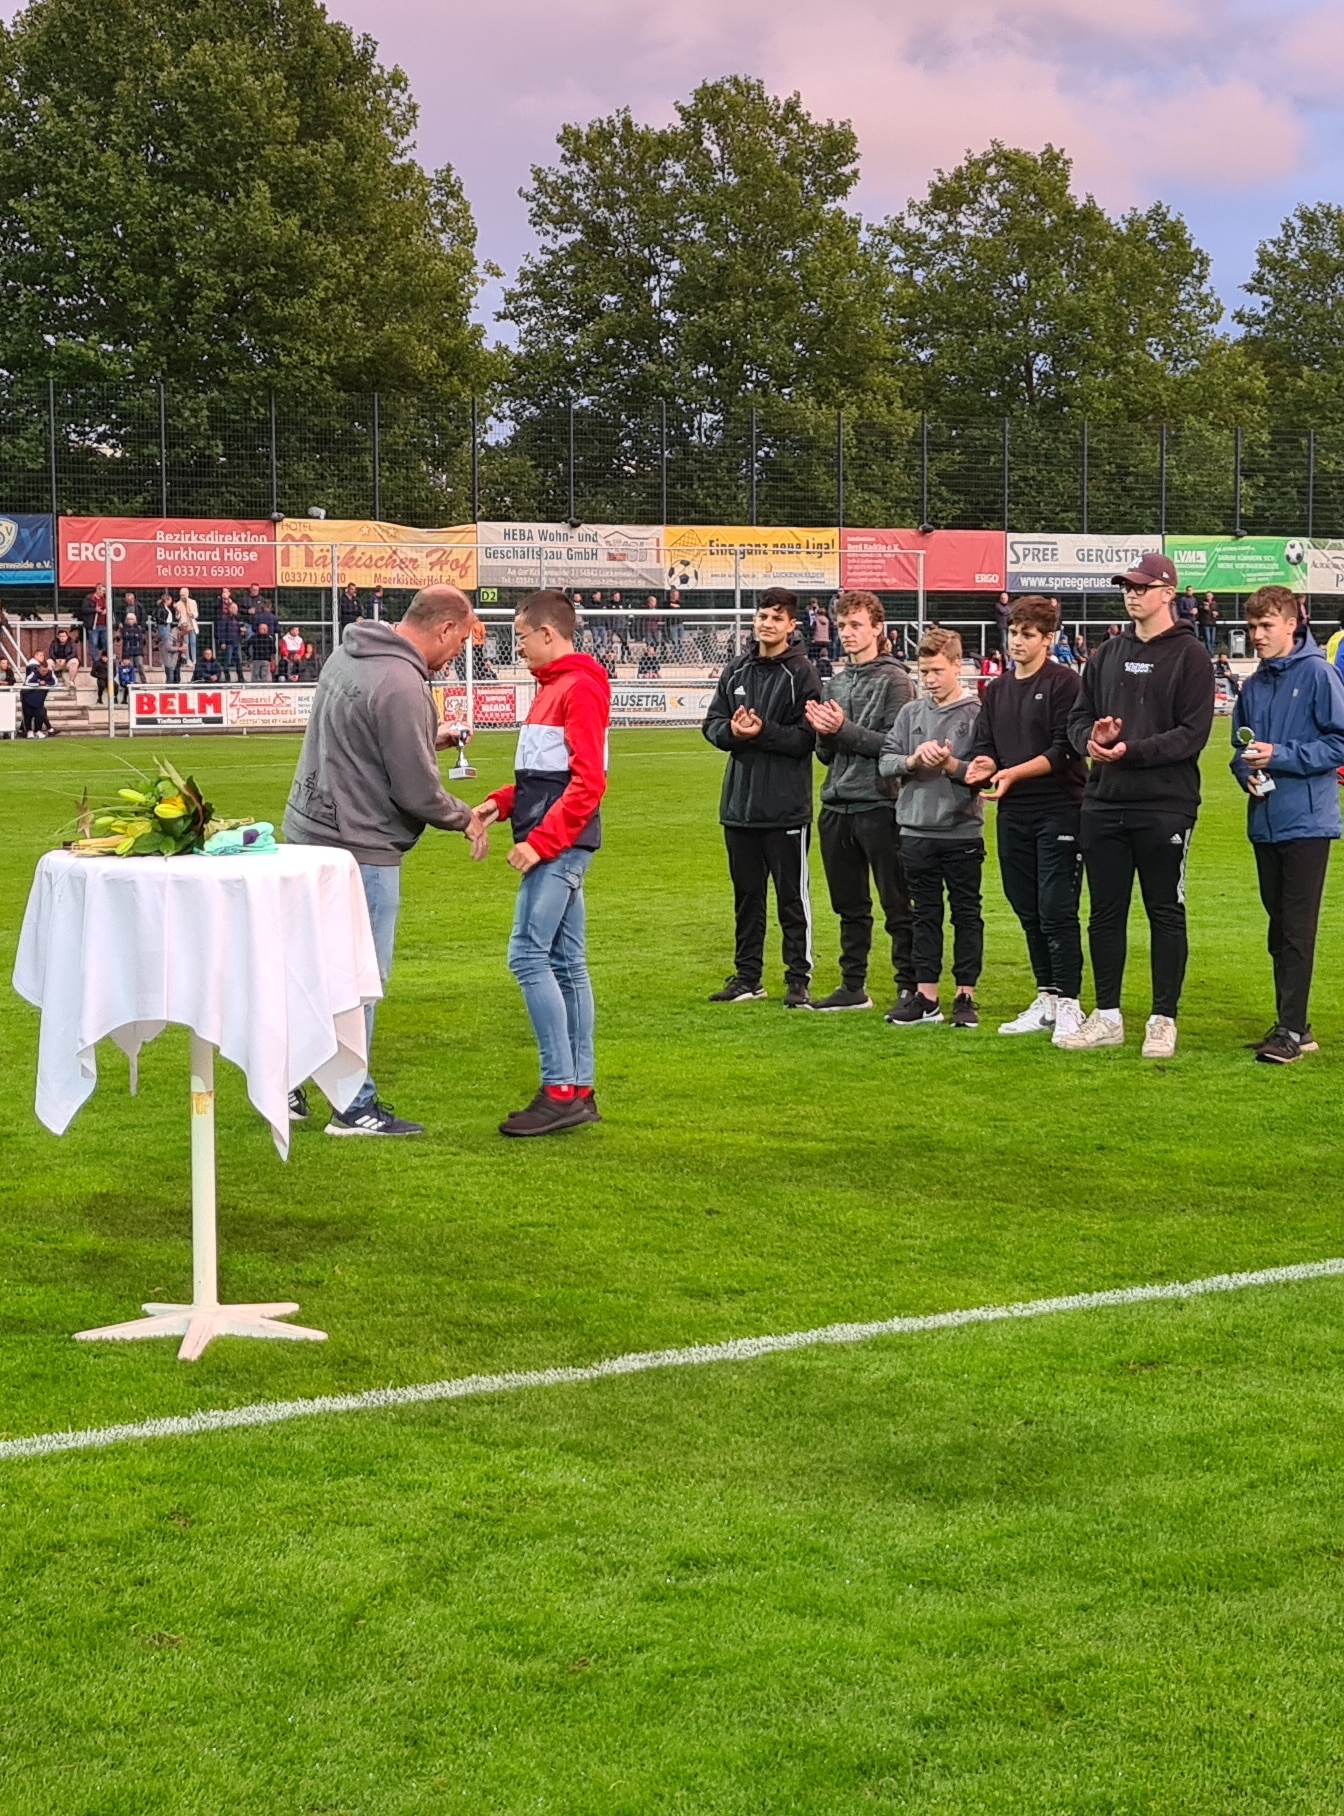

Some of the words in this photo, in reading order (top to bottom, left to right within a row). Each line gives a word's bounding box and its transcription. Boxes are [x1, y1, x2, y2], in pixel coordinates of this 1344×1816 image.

[281, 522, 312, 532] HOTEL
[156, 530, 267, 544] Bezirksdirektion
[503, 528, 534, 541] HEBA
[538, 529, 574, 542] Wohn-
[577, 532, 598, 542] und
[67, 543, 126, 562] ERGO
[156, 547, 220, 562] Burkhard
[224, 547, 258, 562] Höse
[566, 548, 598, 561] GmbH
[709, 539, 735, 555] Eine
[739, 543, 768, 559] ganz
[1010, 541, 1059, 564] SPREE
[426, 547, 474, 578] Hof
[157, 565, 171, 577] Tel
[174, 566, 207, 577] 03371
[210, 566, 245, 577] 69300
[280, 572, 318, 584] (03371)
[975, 573, 999, 583] ERGO
[481, 590, 496, 601] D2
[136, 692, 222, 715] BELM
[608, 694, 666, 707] AUSETRA
